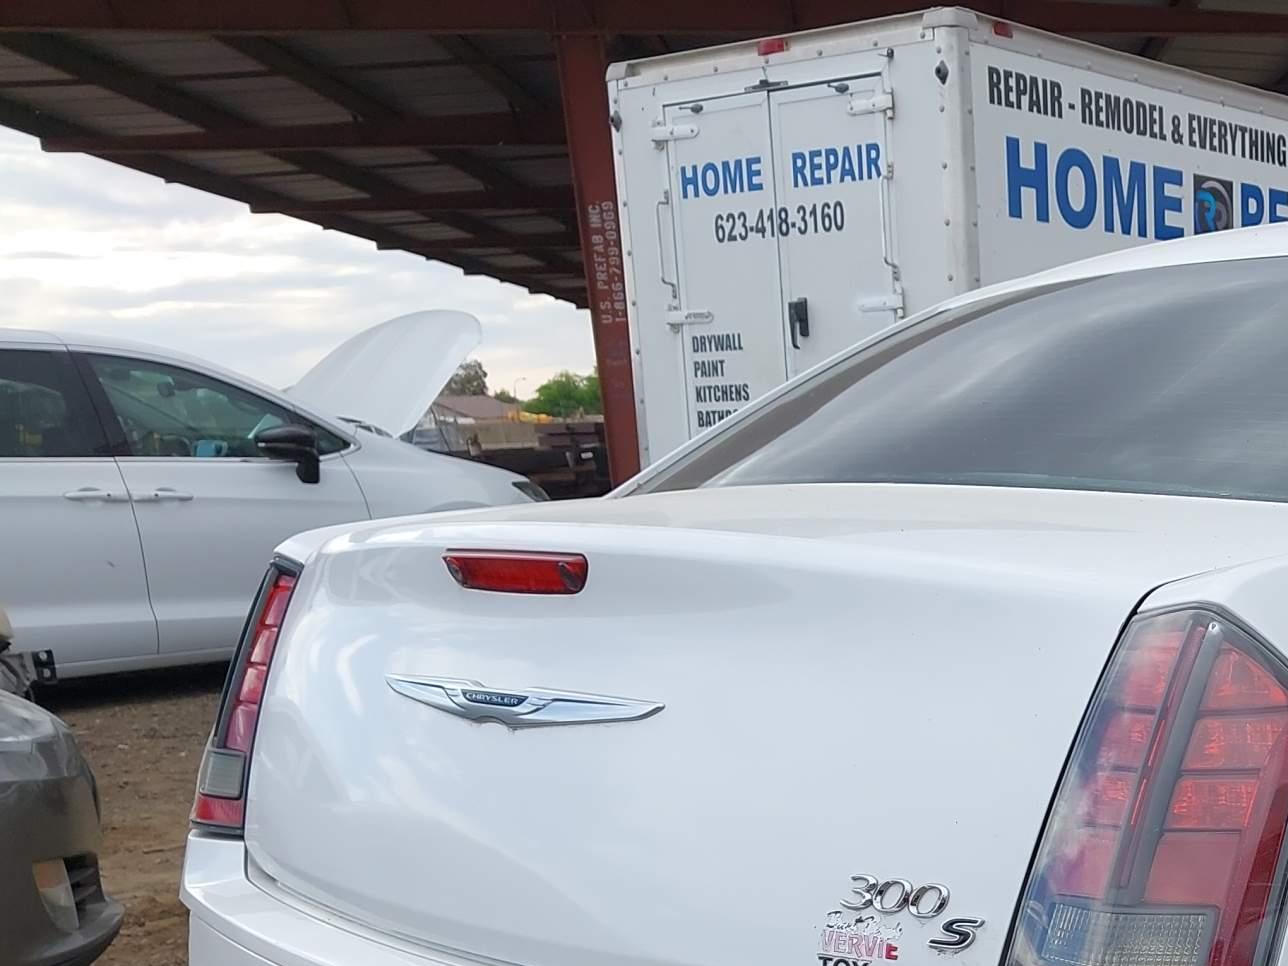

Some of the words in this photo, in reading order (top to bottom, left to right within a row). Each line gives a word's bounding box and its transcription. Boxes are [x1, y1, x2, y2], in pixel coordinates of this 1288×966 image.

[988, 64, 1064, 119] REPAIR
[1080, 86, 1168, 142] REMODEL
[1170, 116, 1184, 146] &
[1187, 112, 1288, 169] EVERYTHING
[680, 156, 764, 200] HOME
[790, 142, 882, 189] REPAIR
[1005, 136, 1185, 241] HOME
[714, 200, 846, 244] 623-418-3160
[692, 332, 744, 353] DRYWALL
[693, 359, 726, 378] PAINT
[695, 383, 750, 403] KITCHENS
[465, 691, 520, 706] CHRYSLER
[839, 873, 951, 919] 300
[926, 916, 986, 950] S
